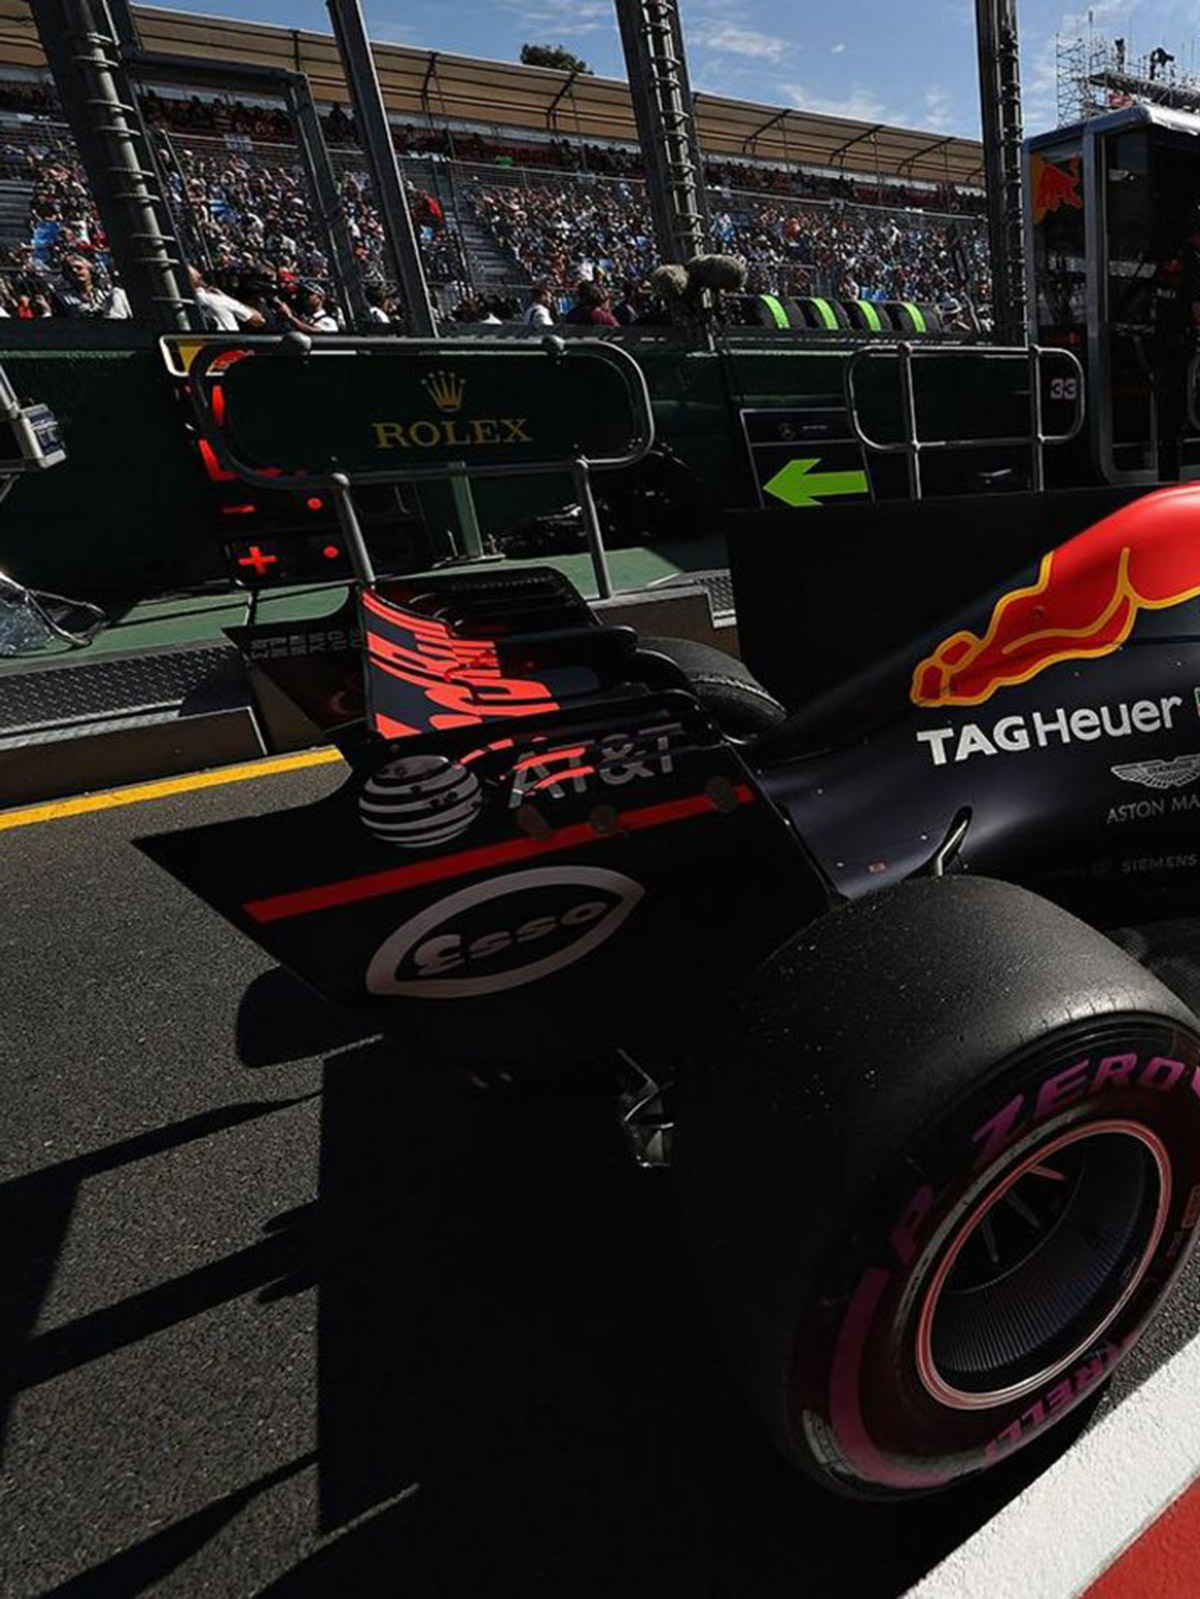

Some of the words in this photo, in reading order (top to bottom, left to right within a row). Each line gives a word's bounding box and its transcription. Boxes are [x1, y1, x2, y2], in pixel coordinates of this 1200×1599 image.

[1050, 377, 1077, 400] 33
[371, 418, 535, 449] ROLEX
[507, 721, 683, 809] AT&T
[1105, 798, 1165, 825] ASTON
[1121, 853, 1199, 875] SIEMENS
[413, 900, 608, 977] Esso
[969, 1052, 1186, 1165] ZERO
